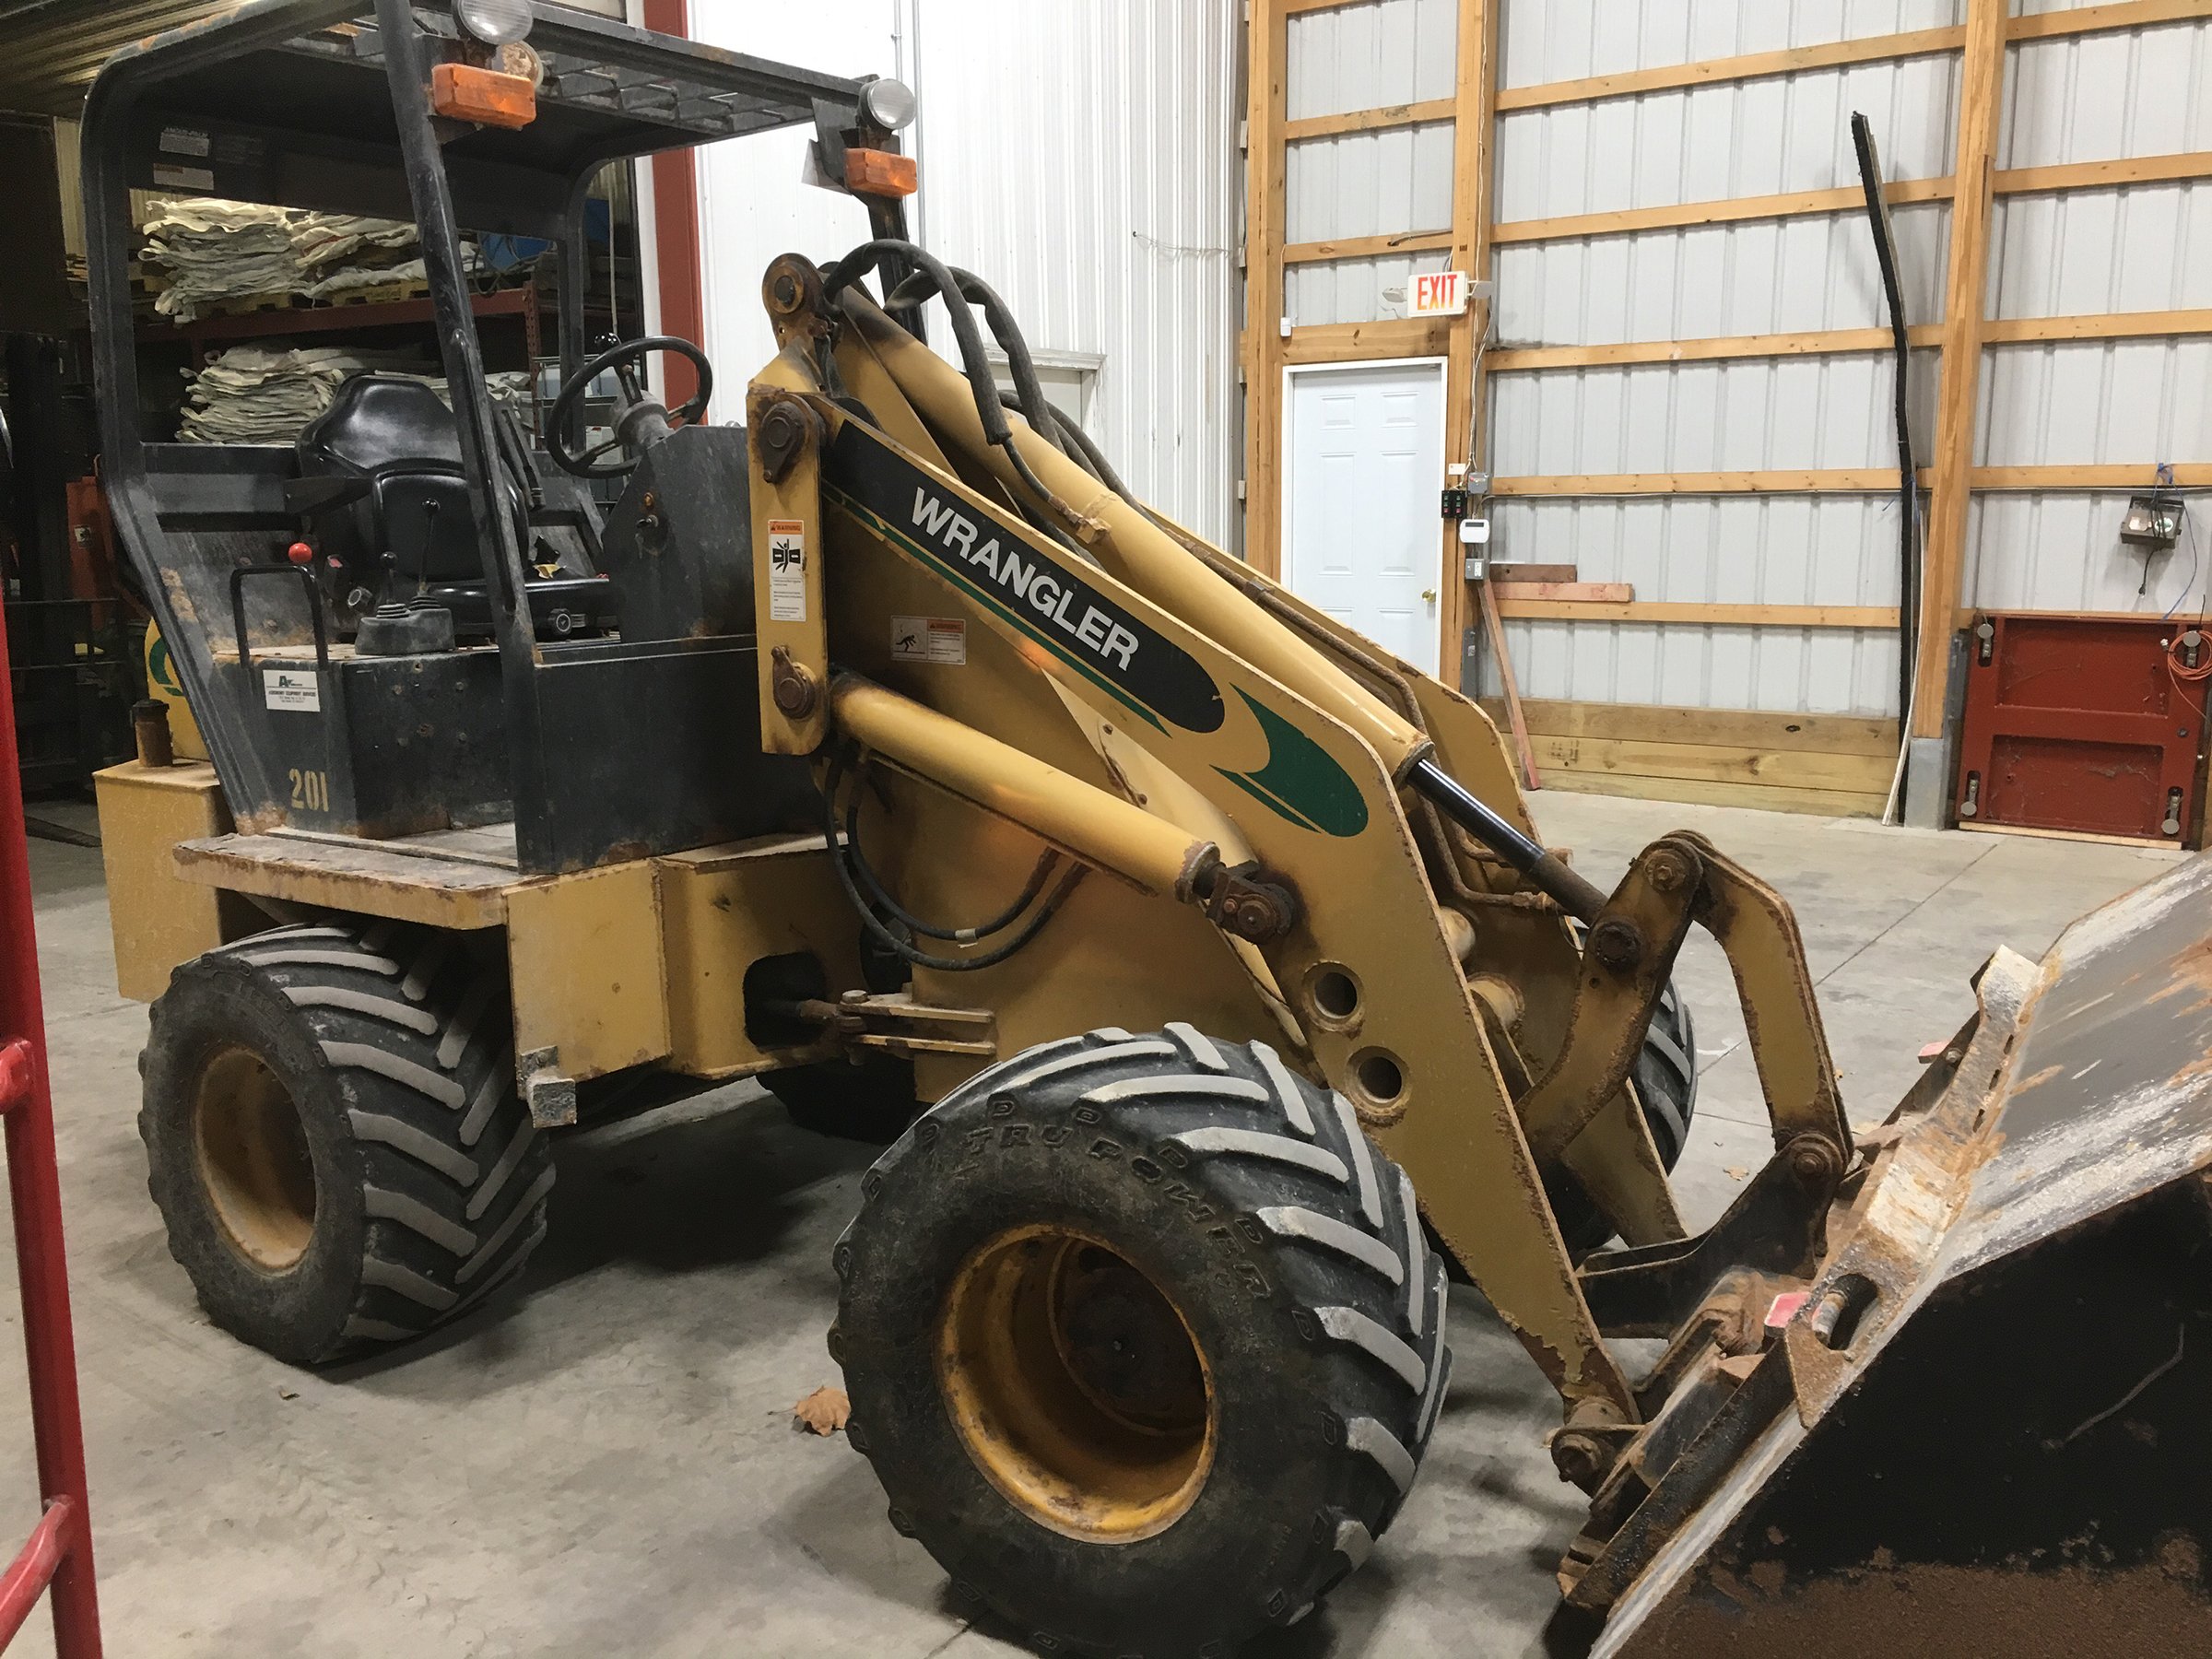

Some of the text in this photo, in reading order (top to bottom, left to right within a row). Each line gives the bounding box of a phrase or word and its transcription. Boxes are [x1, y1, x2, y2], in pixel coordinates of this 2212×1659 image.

[1417, 274, 1457, 311] EXIT
[911, 487, 1139, 672] WRANGLER
[288, 768, 330, 813] 201
[967, 1124, 1271, 1299] TRU POWER
